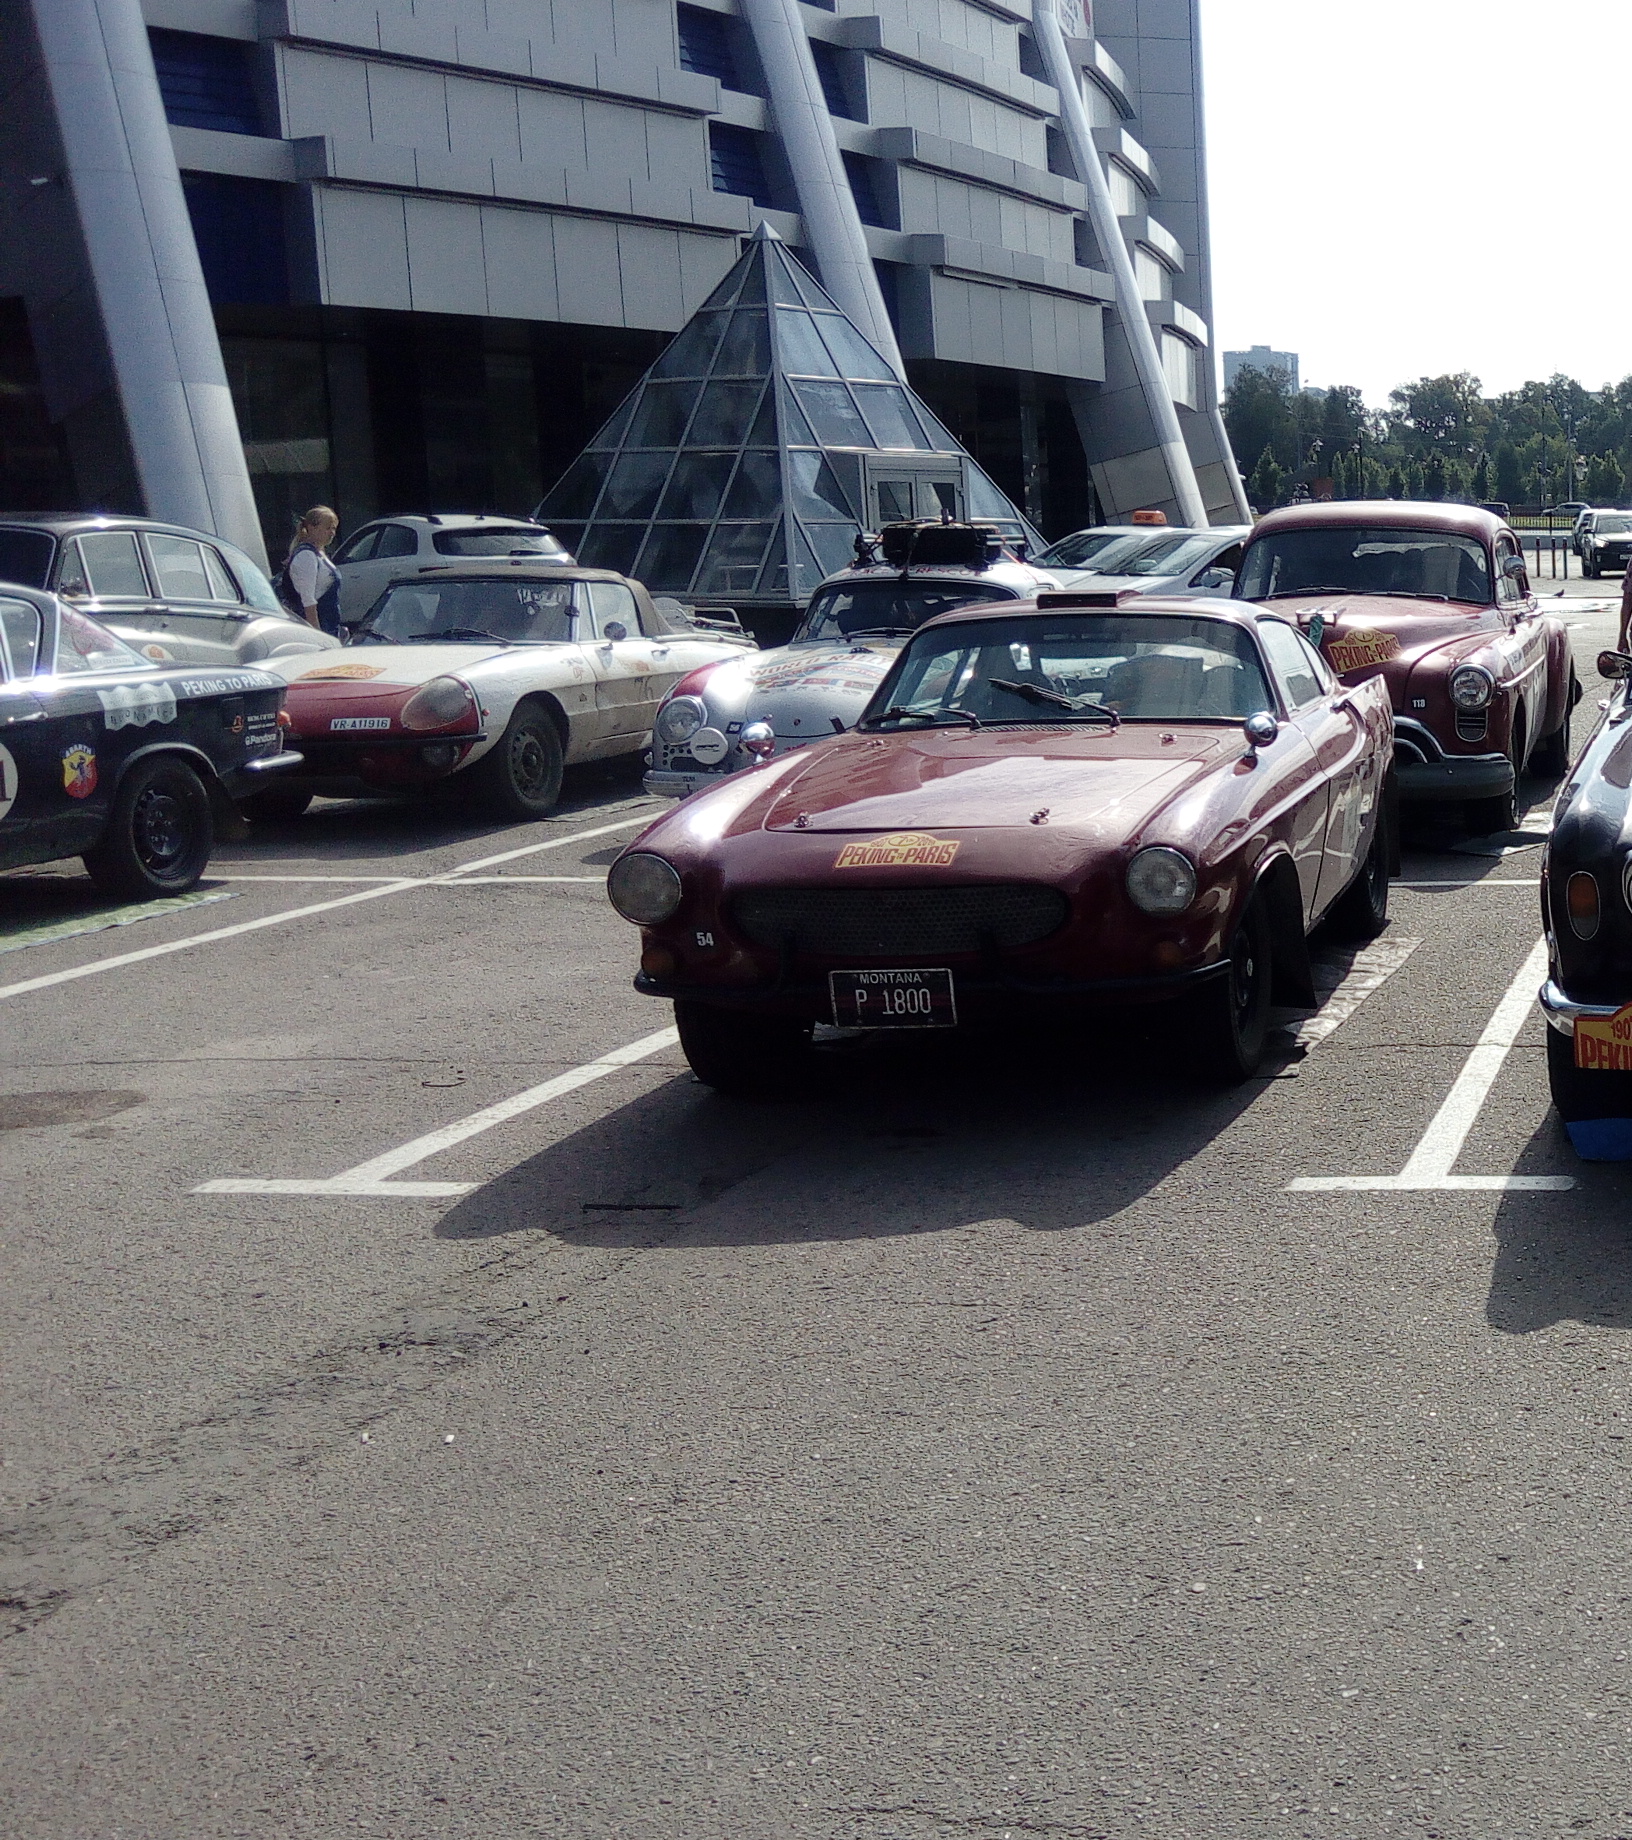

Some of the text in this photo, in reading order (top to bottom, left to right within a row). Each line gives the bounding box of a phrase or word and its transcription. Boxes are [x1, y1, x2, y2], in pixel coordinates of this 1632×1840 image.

[828, 653, 894, 666] RALLY
[1329, 645, 1376, 672] PEKING
[181, 678, 226, 697] PEKING
[227, 676, 243, 690] TO
[242, 672, 274, 688] PARIS
[332, 719, 388, 729] VR-A11916
[65, 744, 92, 757] ABARTH
[838, 845, 900, 866] PEKING
[902, 843, 957, 864] PARIS
[696, 932, 714, 946] 54
[859, 972, 922, 984] MONTANA
[855, 987, 931, 1015] P 1800
